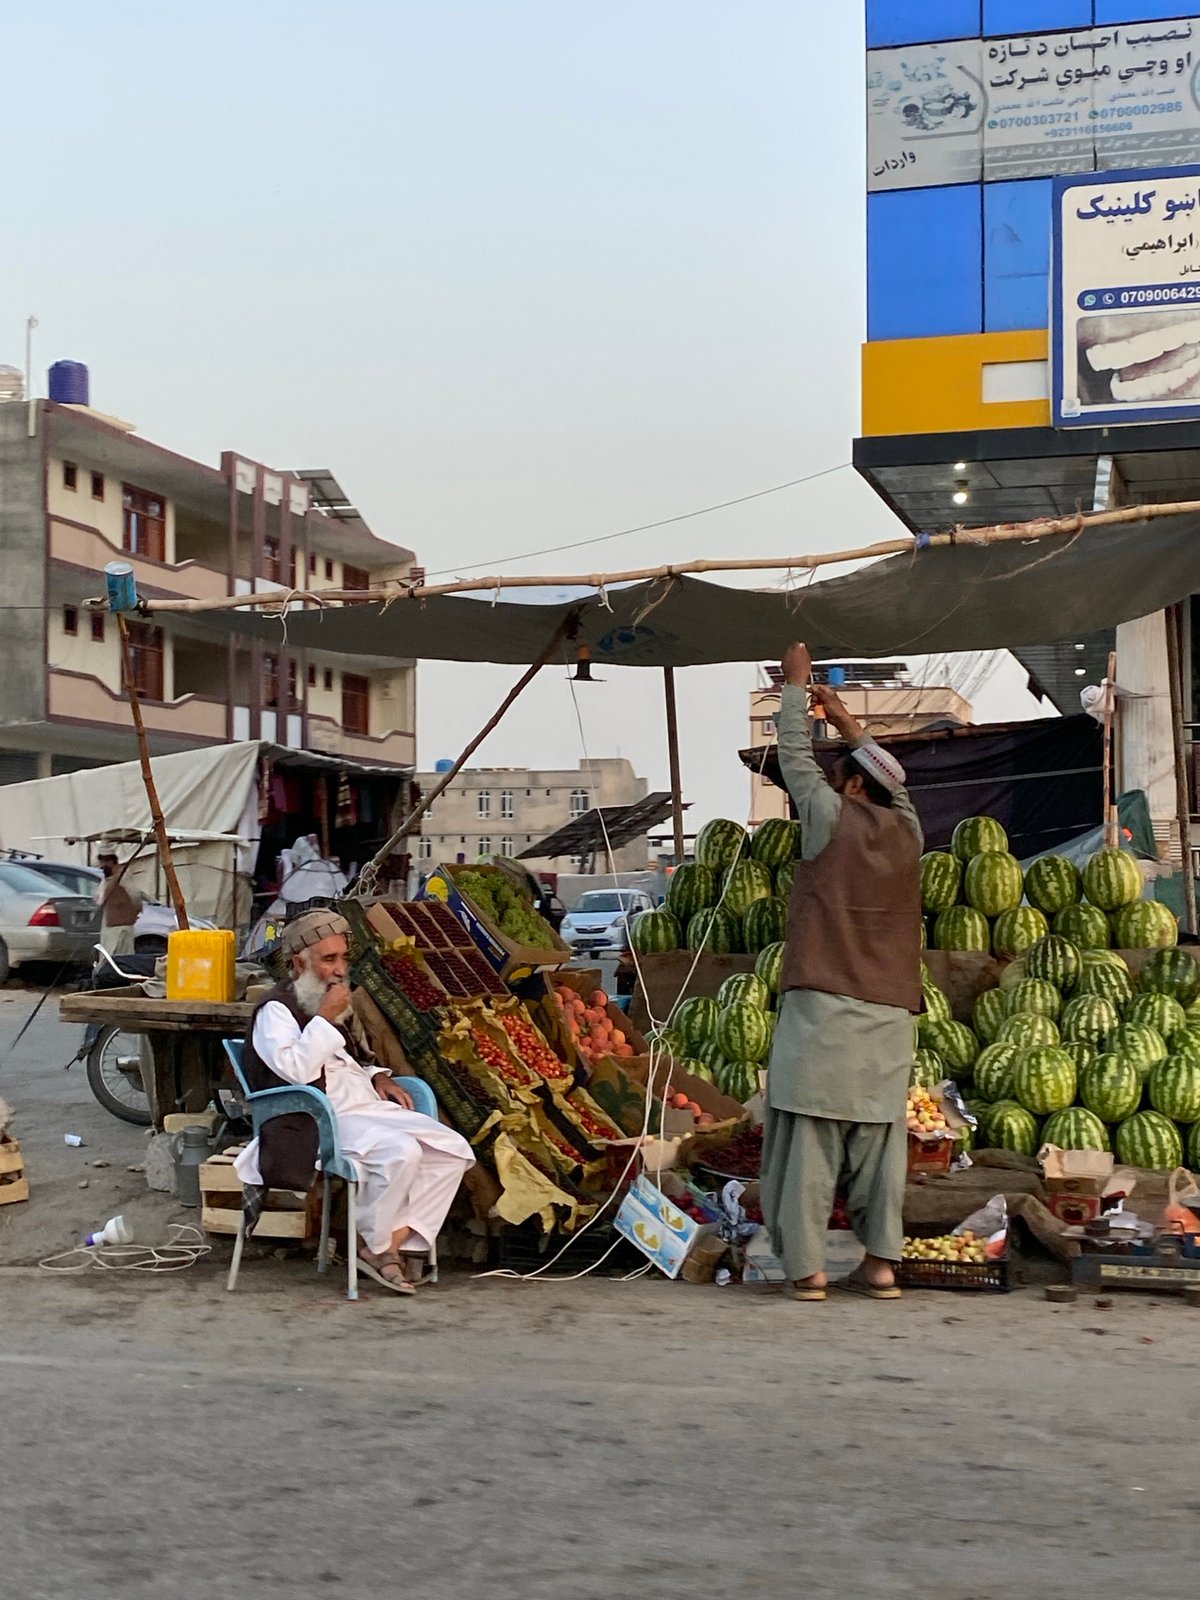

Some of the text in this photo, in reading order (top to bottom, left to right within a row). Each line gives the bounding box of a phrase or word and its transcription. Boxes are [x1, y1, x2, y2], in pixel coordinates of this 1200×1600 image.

[988, 39, 1030, 63] تازه
[1037, 42, 1048, 56] د
[1054, 30, 1119, 57] احسان
[1174, 51, 1192, 74] او
[989, 66, 1049, 90] شرکت
[1000, 112, 1078, 128] 0700303721
[872, 151, 916, 177] واردات
